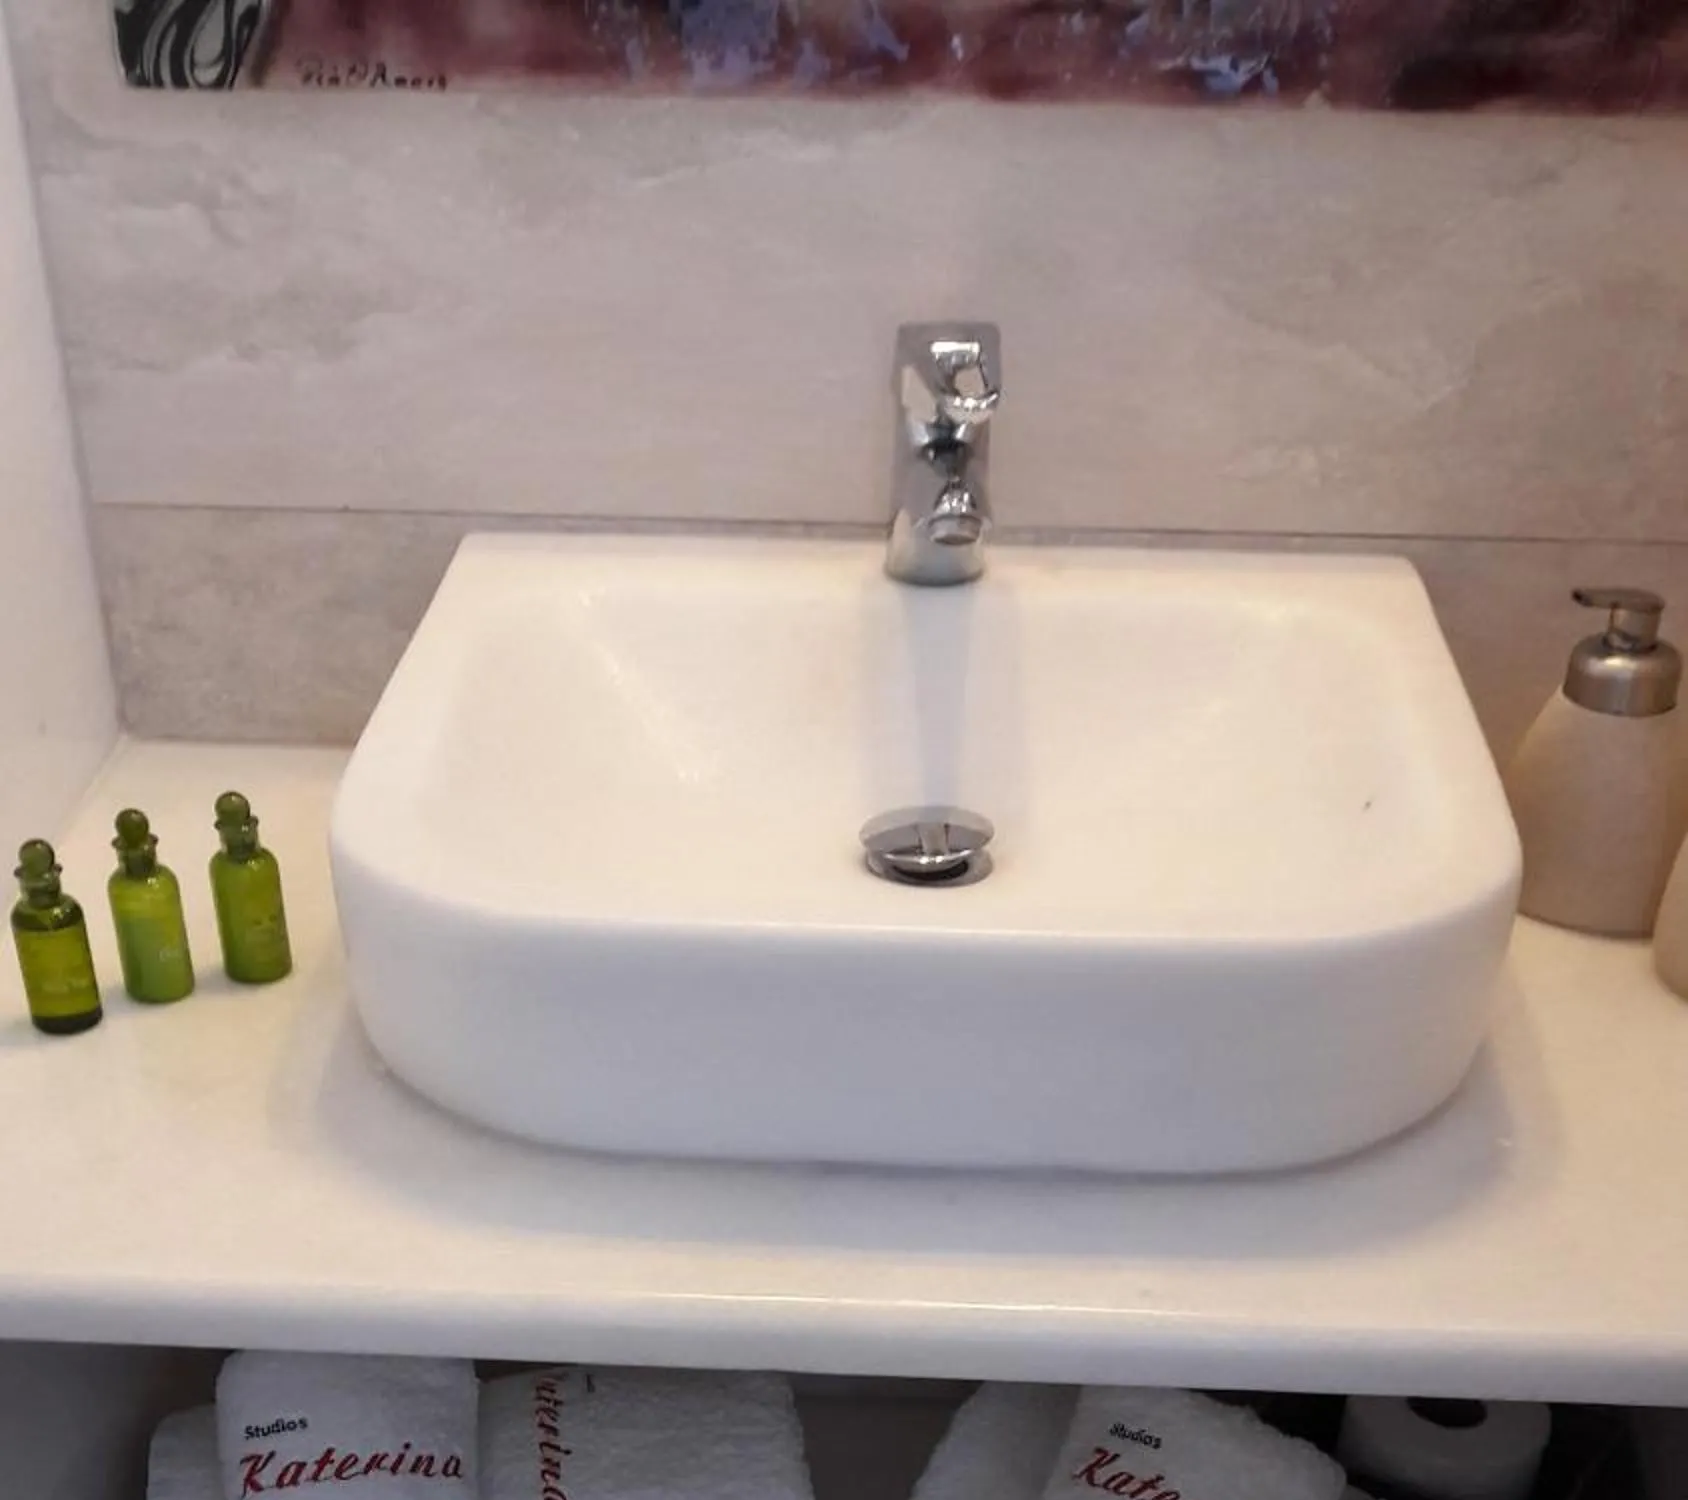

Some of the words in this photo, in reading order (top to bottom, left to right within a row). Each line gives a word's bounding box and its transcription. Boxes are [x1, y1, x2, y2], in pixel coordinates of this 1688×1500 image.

[243, 1416, 309, 1441] Studios
[1109, 1422, 1162, 1449] Studios
[239, 1441, 464, 1500] Katerina
